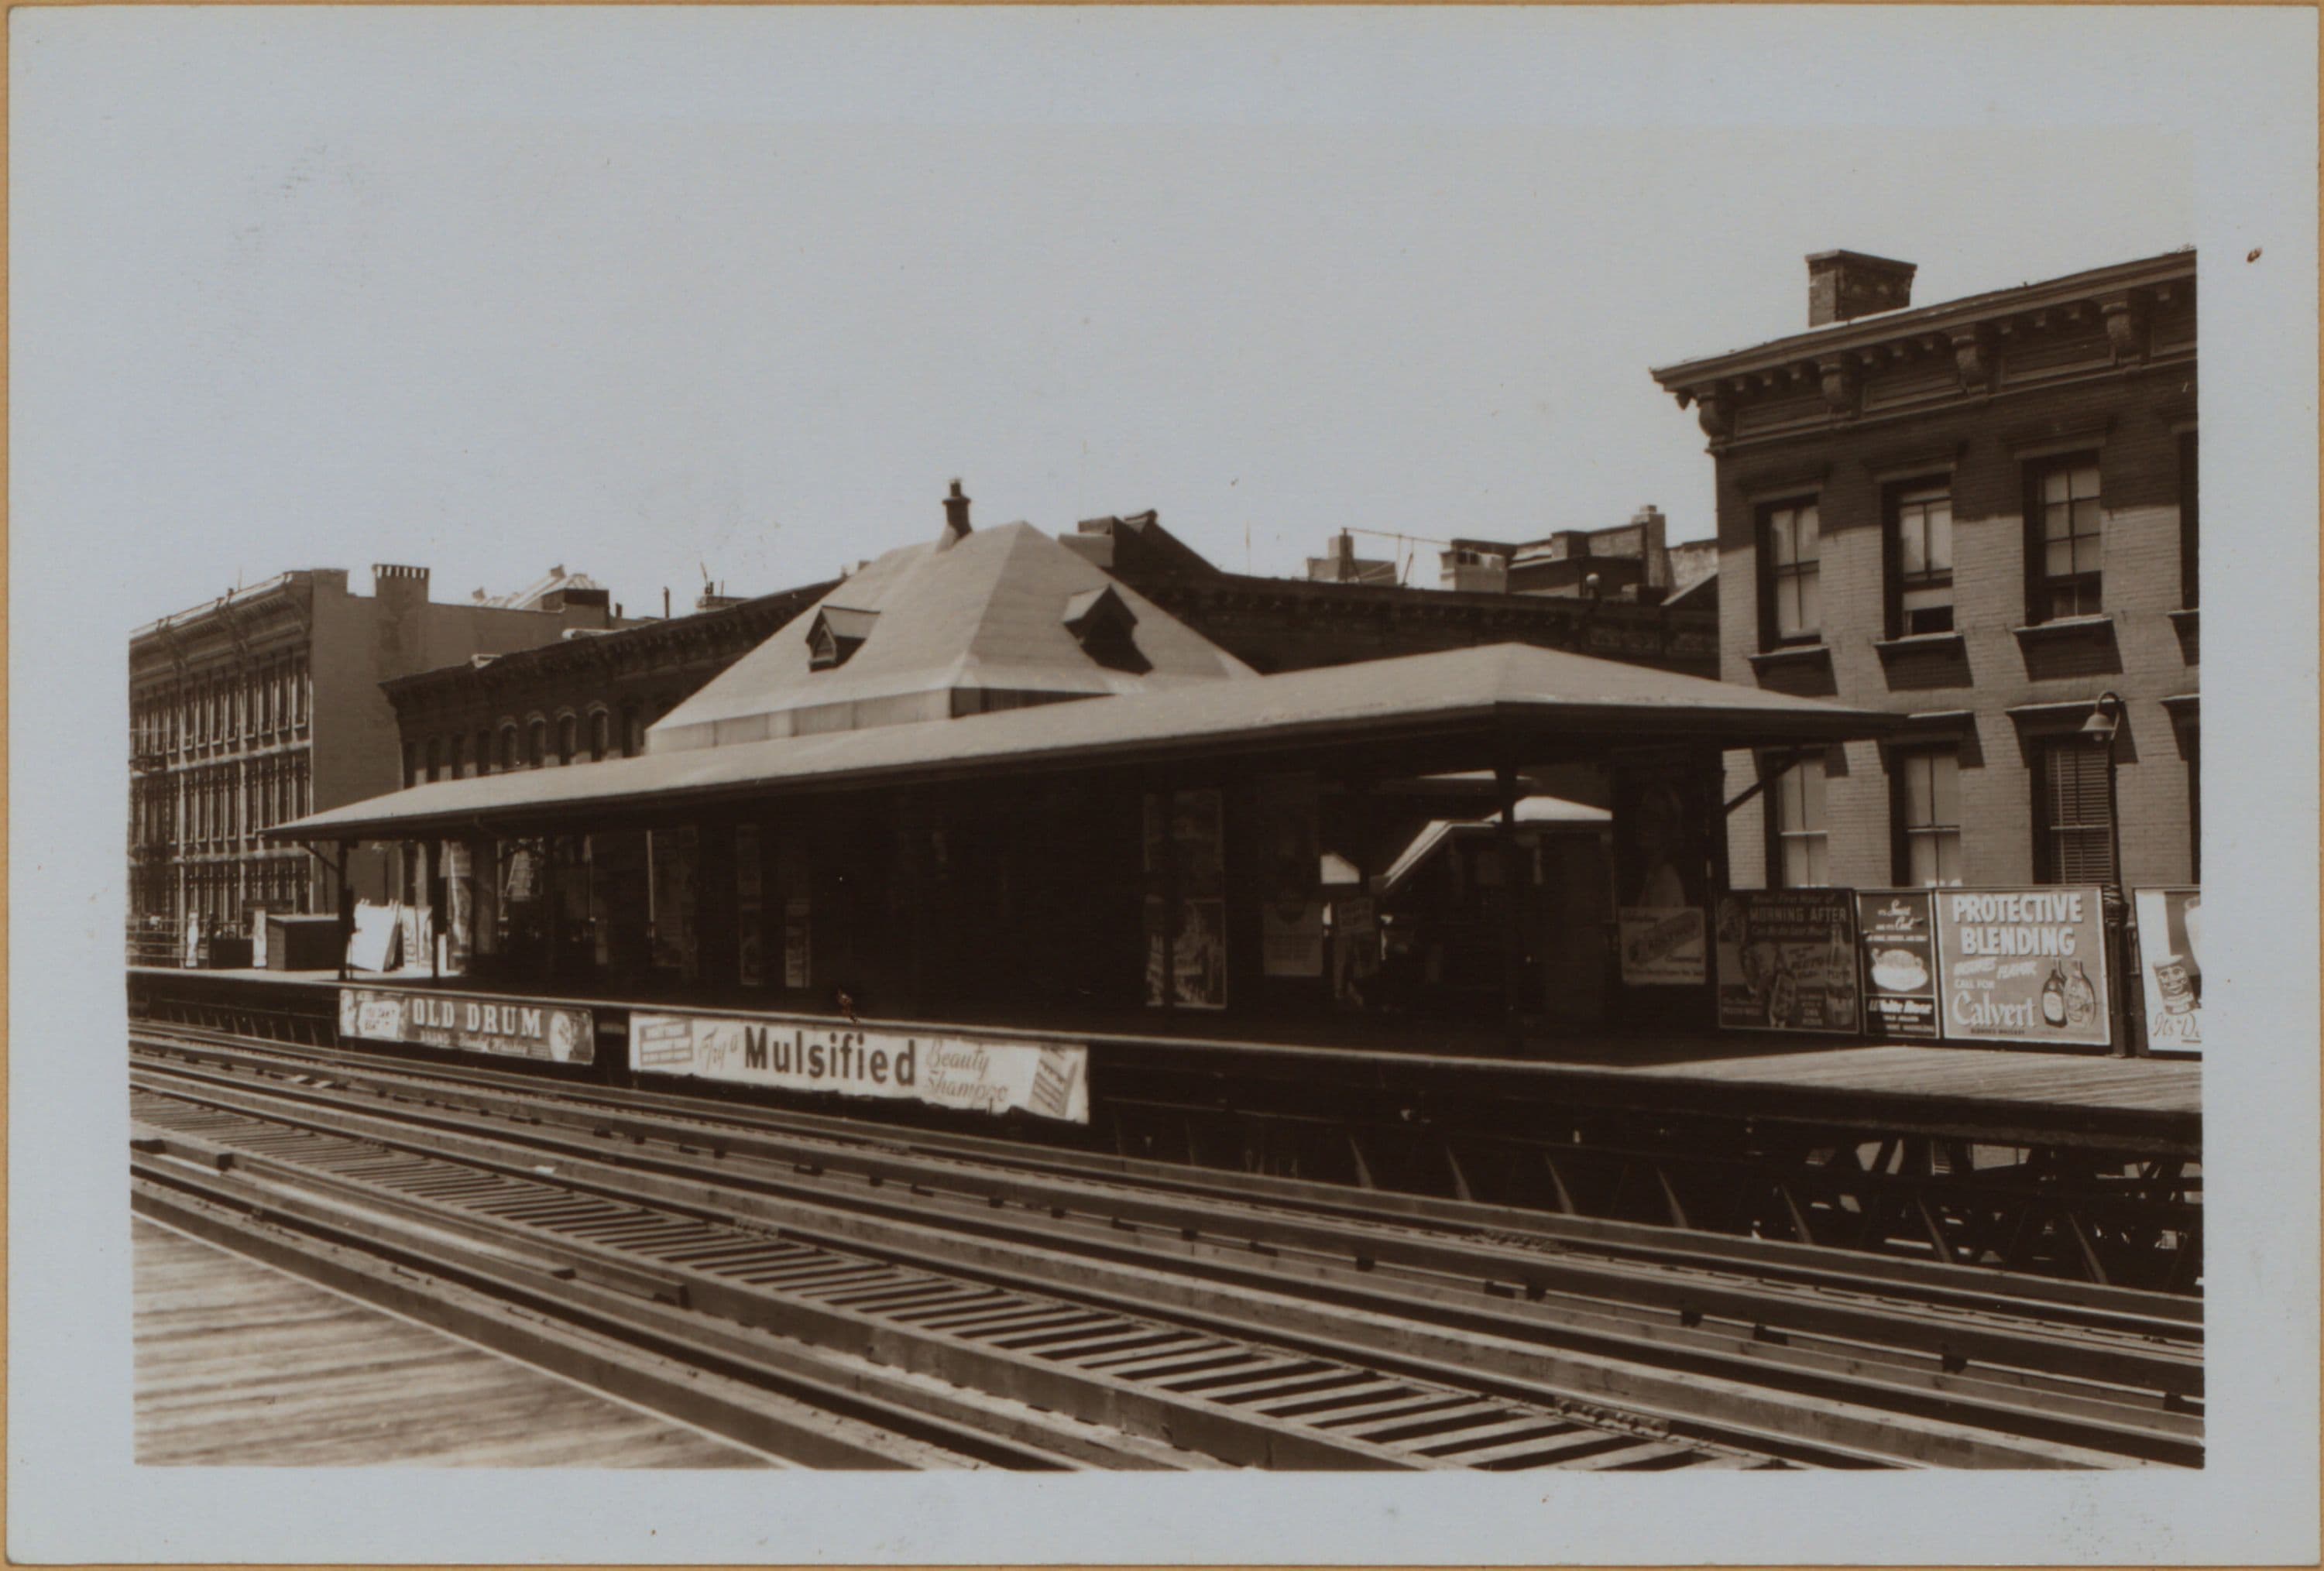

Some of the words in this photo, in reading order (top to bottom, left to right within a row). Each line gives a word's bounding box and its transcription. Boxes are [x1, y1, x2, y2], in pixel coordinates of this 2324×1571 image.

[1749, 907, 1804, 923] MORNING
[1810, 907, 1847, 923] AFTER
[1952, 893, 2084, 924] PROTECTIVE
[1960, 926, 2077, 957] BLENDING
[1954, 979, 1974, 989] CALL
[1976, 979, 1995, 989] FOR
[412, 997, 455, 1029] OLD
[466, 1003, 542, 1039] DRUM
[1952, 990, 2037, 1028] Calvert
[744, 1025, 915, 1088] Mulsified
[926, 1037, 990, 1080] Beauty
